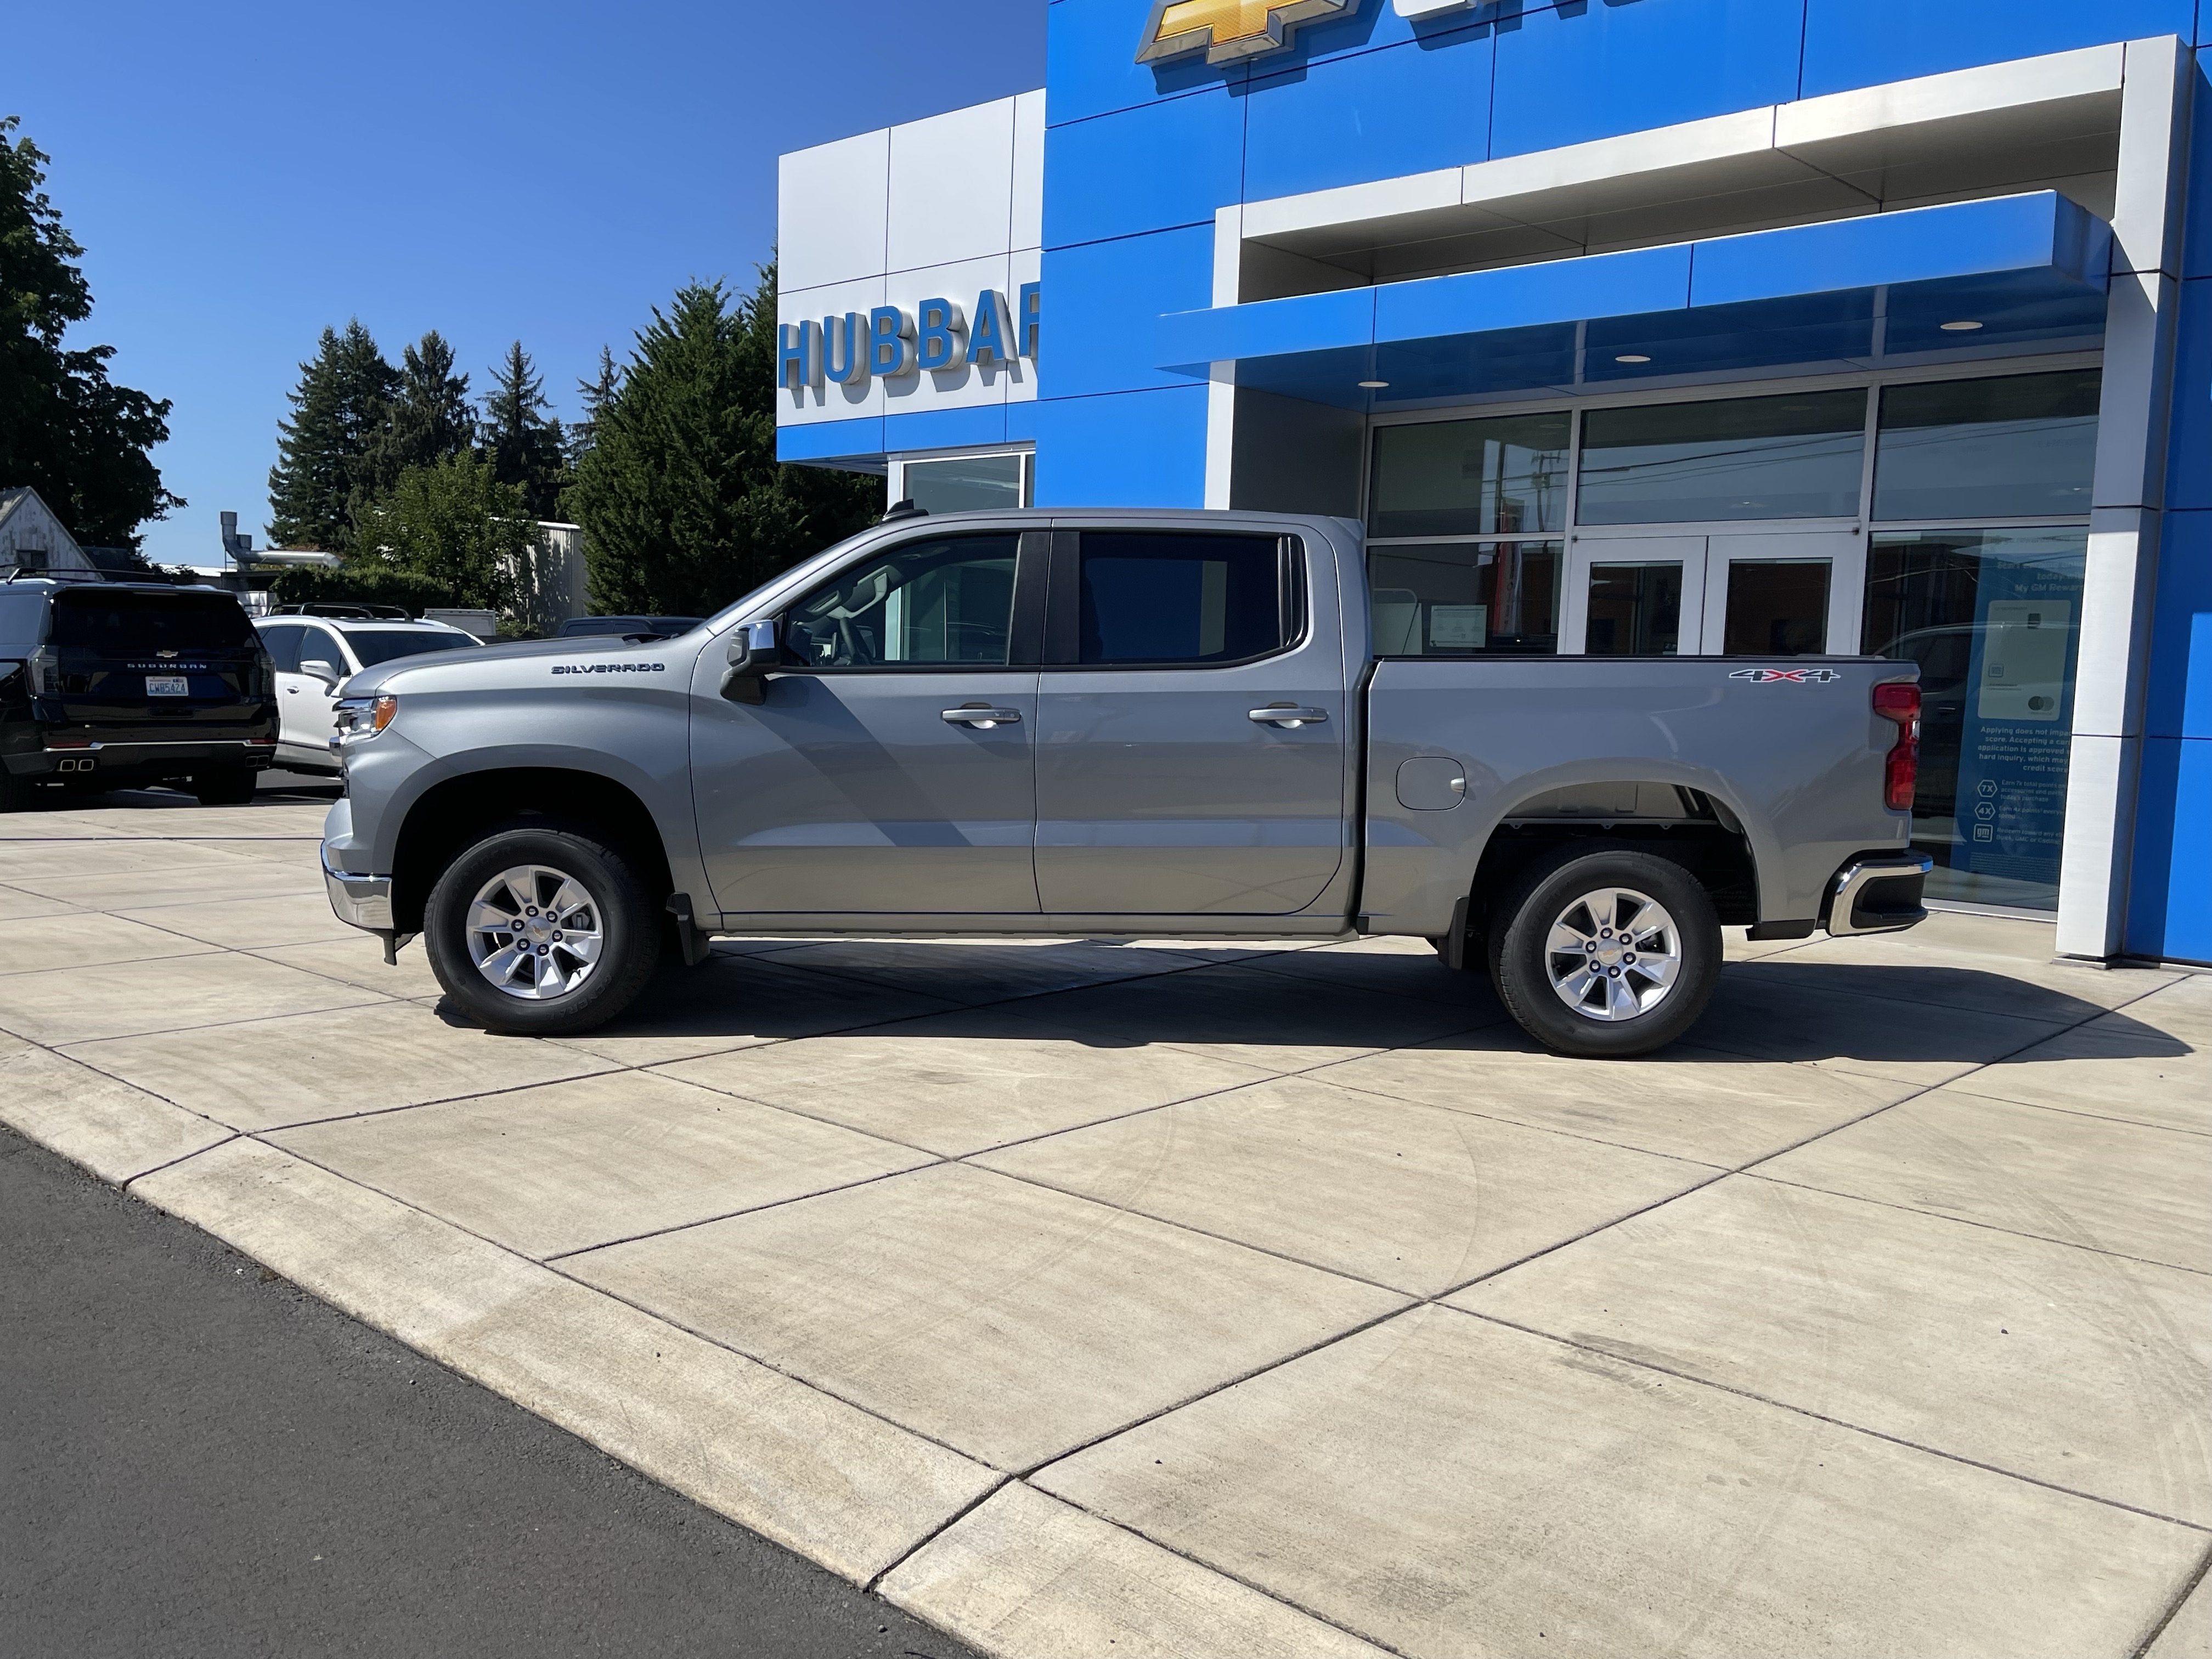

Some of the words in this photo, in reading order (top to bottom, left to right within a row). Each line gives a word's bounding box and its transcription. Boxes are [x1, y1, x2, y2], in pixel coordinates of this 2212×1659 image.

[2015, 584, 2029, 593] My
[551, 663, 665, 674] SILVERADO
[1980, 726, 2013, 735] Applying
[2009, 736, 2047, 746] Accepting
[1978, 807, 1991, 815] 4X
